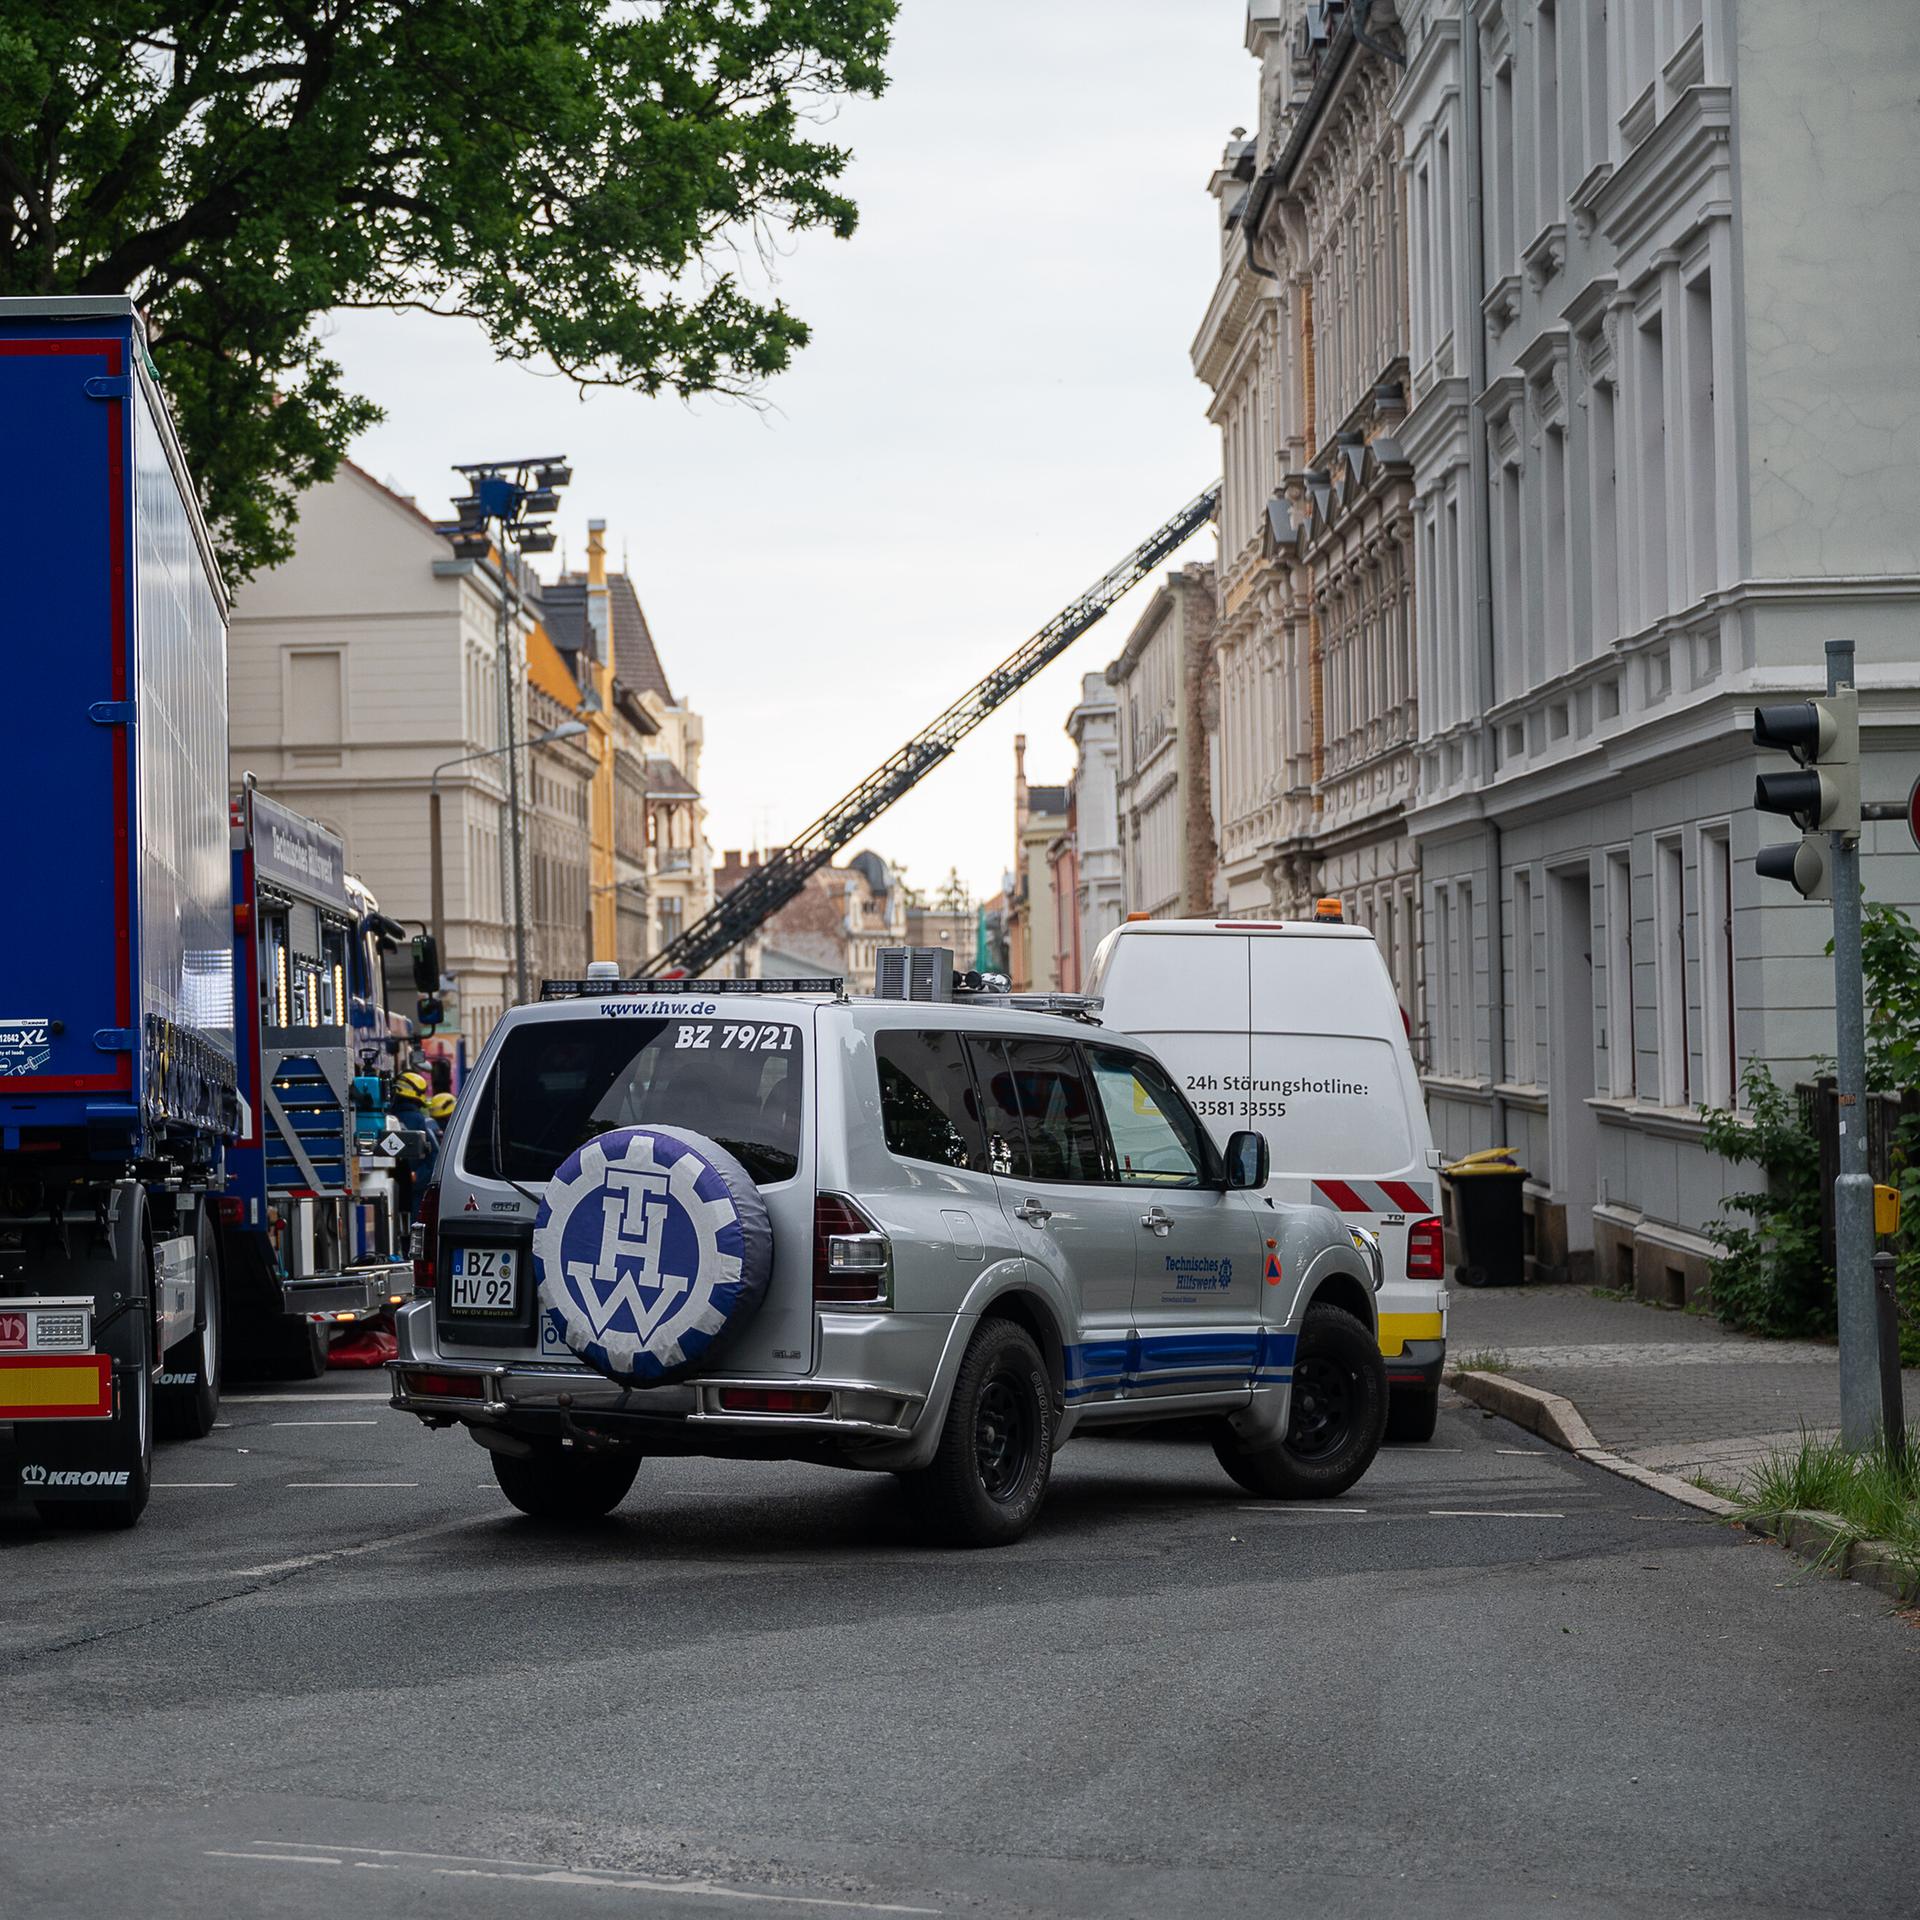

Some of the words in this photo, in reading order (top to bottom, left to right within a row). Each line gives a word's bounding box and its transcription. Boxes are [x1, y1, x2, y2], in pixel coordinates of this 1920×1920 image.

[600, 1001, 716, 1015] www.thw.de
[18, 1029, 47, 1048] XL
[674, 1026, 713, 1048] BZ
[721, 1026, 793, 1051] 79/21
[1187, 1076, 1217, 1090] 24h
[1223, 1076, 1368, 1096] Störungshotline:
[1240, 1102, 1286, 1117] 33555
[467, 1252, 495, 1277] BZ
[1165, 1256, 1218, 1271] Technisches
[1176, 1275, 1217, 1290] Hilfswerk
[454, 1279, 481, 1304] HV
[486, 1280, 511, 1305] 92
[154, 1373, 197, 1384] ONE
[47, 1471, 130, 1486] KRONE
